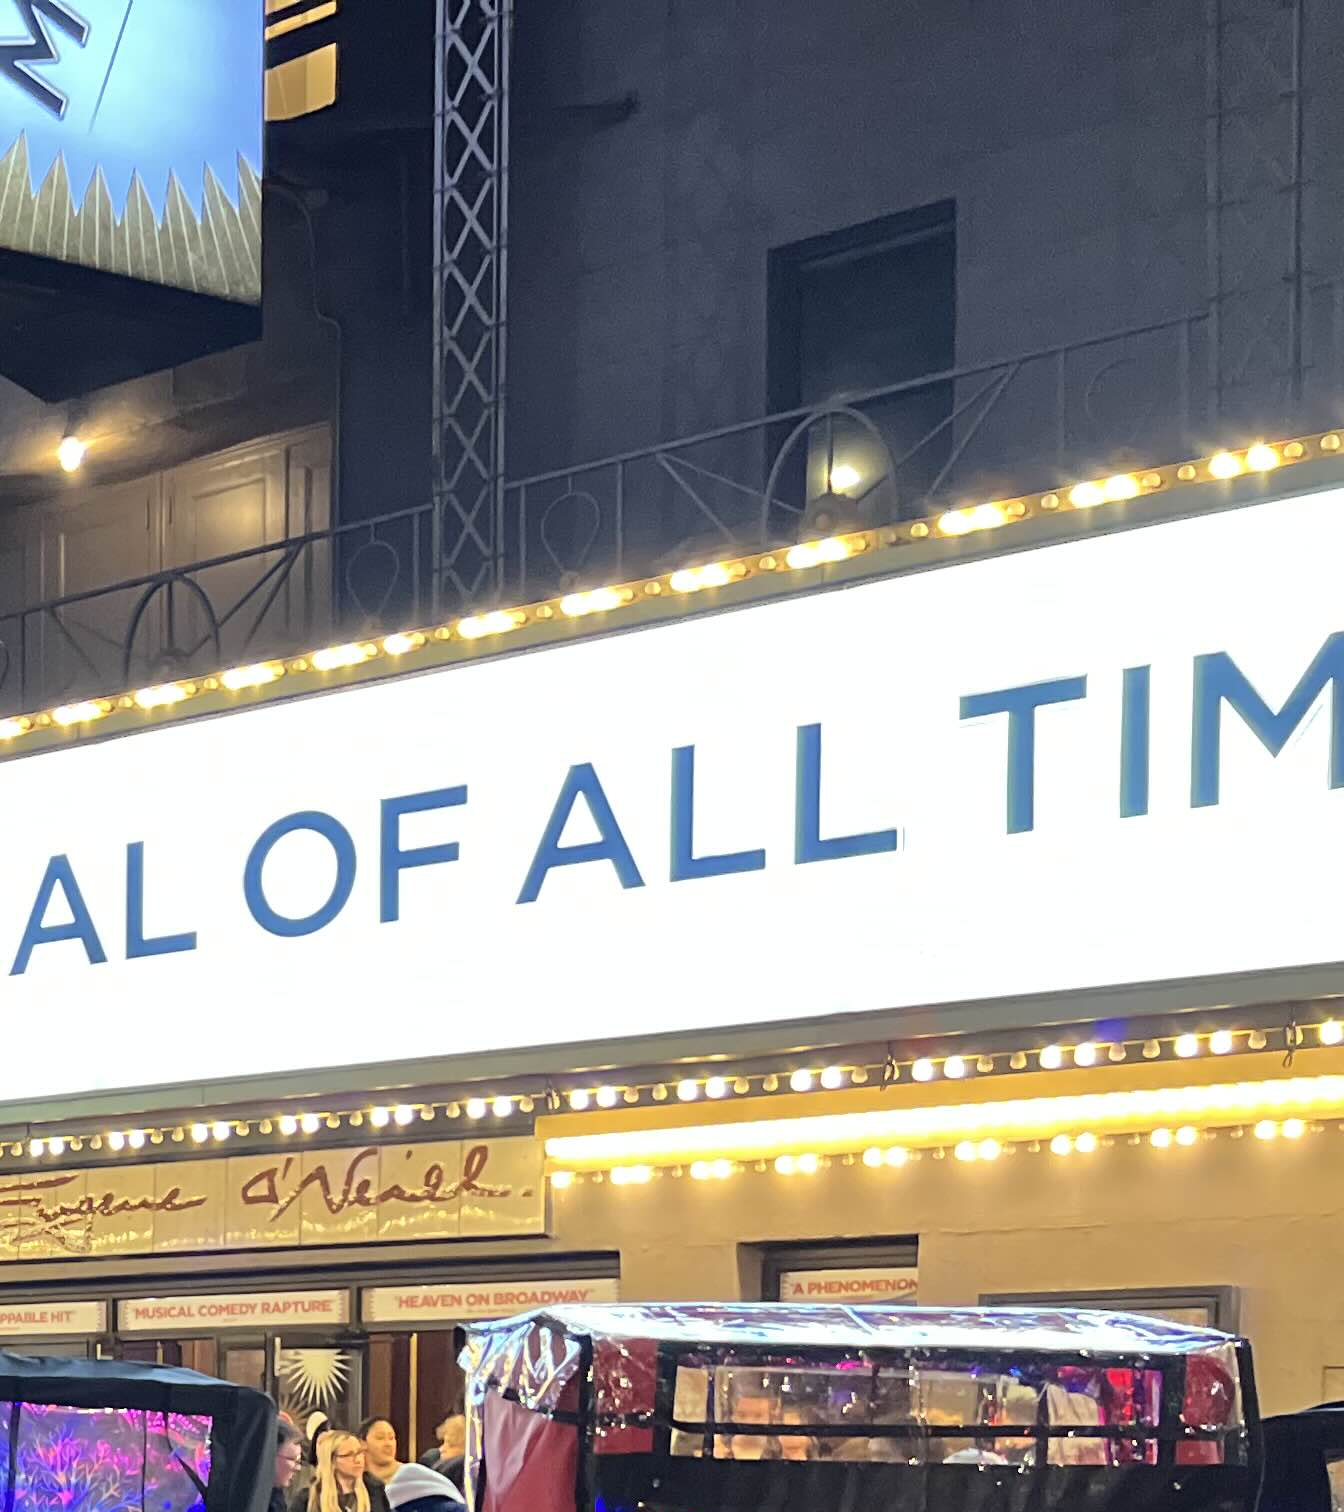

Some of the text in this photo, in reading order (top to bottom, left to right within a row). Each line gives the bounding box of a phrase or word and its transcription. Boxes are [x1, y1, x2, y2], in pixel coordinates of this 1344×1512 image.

[243, 785, 468, 938] OF
[516, 723, 899, 905] ALL
[807, 1278, 918, 1294] PHENOMENON
[465, 1292, 491, 1305] ON
[197, 1302, 258, 1316] COMEDY
